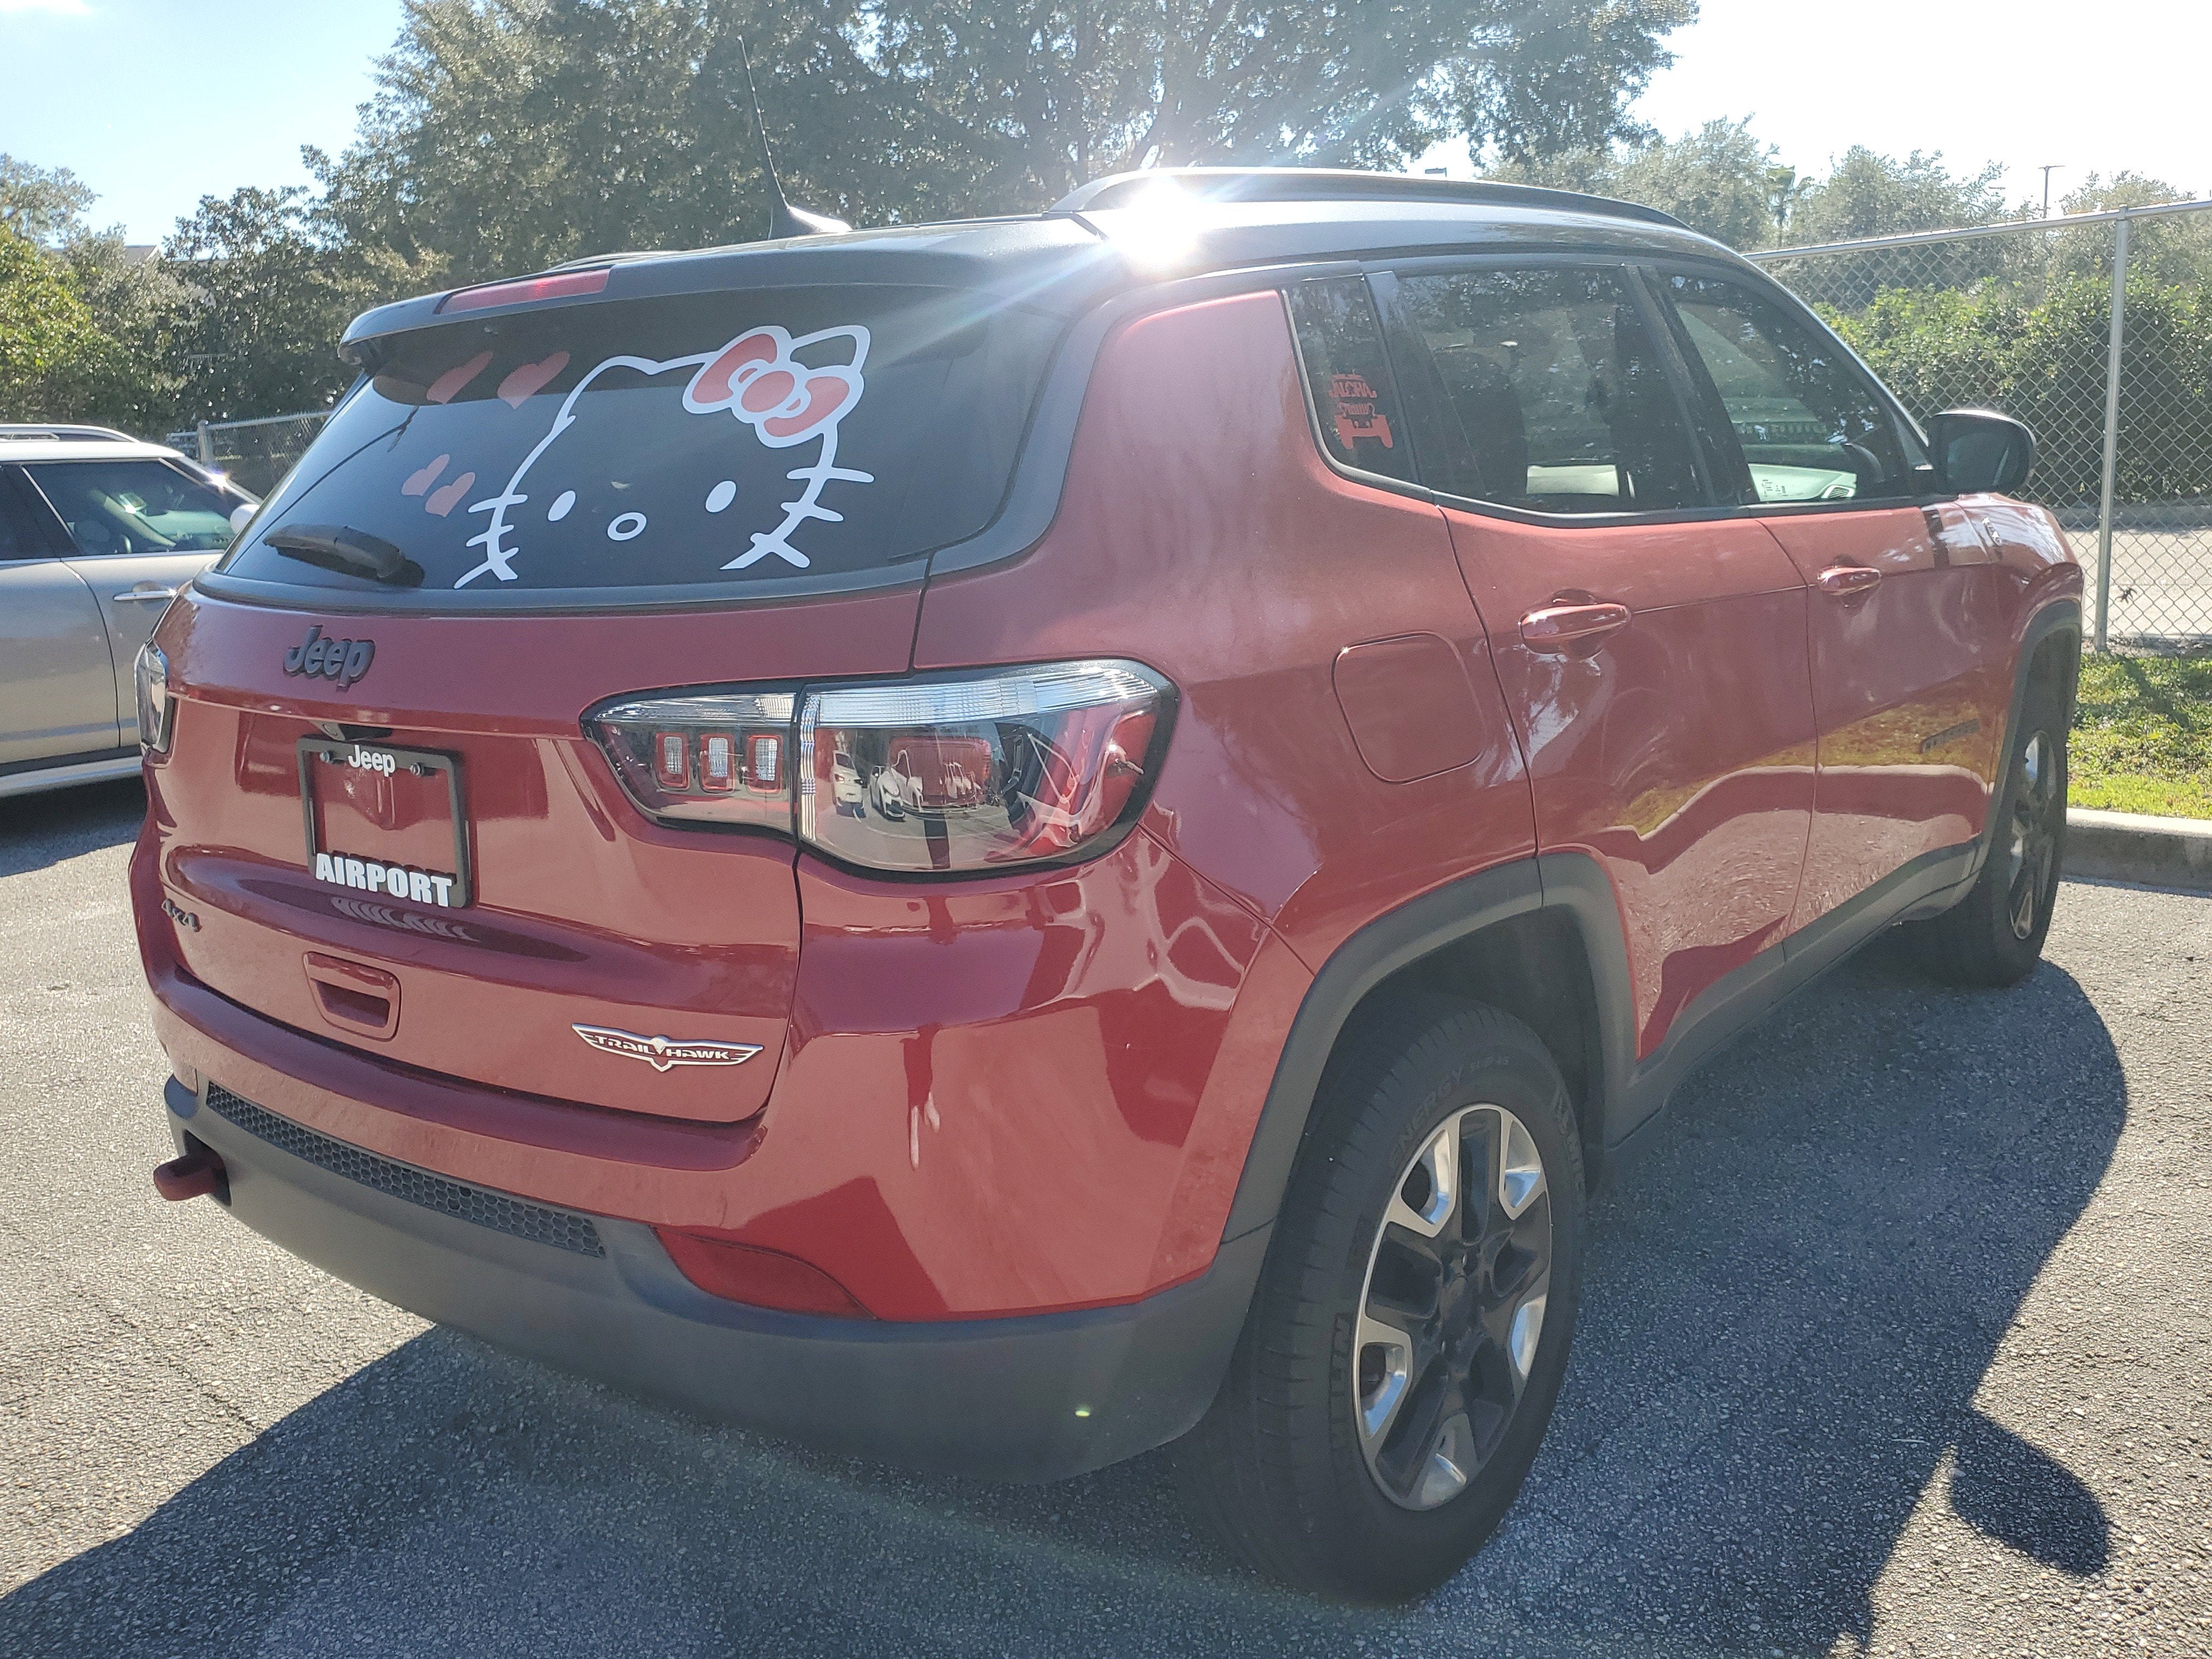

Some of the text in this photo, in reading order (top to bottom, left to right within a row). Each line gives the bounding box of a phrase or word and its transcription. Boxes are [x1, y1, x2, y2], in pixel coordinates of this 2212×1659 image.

[284, 625, 376, 691] Jeep
[348, 744, 396, 777] Jeep
[316, 853, 452, 907] AIRPORT
[1389, 1065, 1464, 1169] ENERGY
